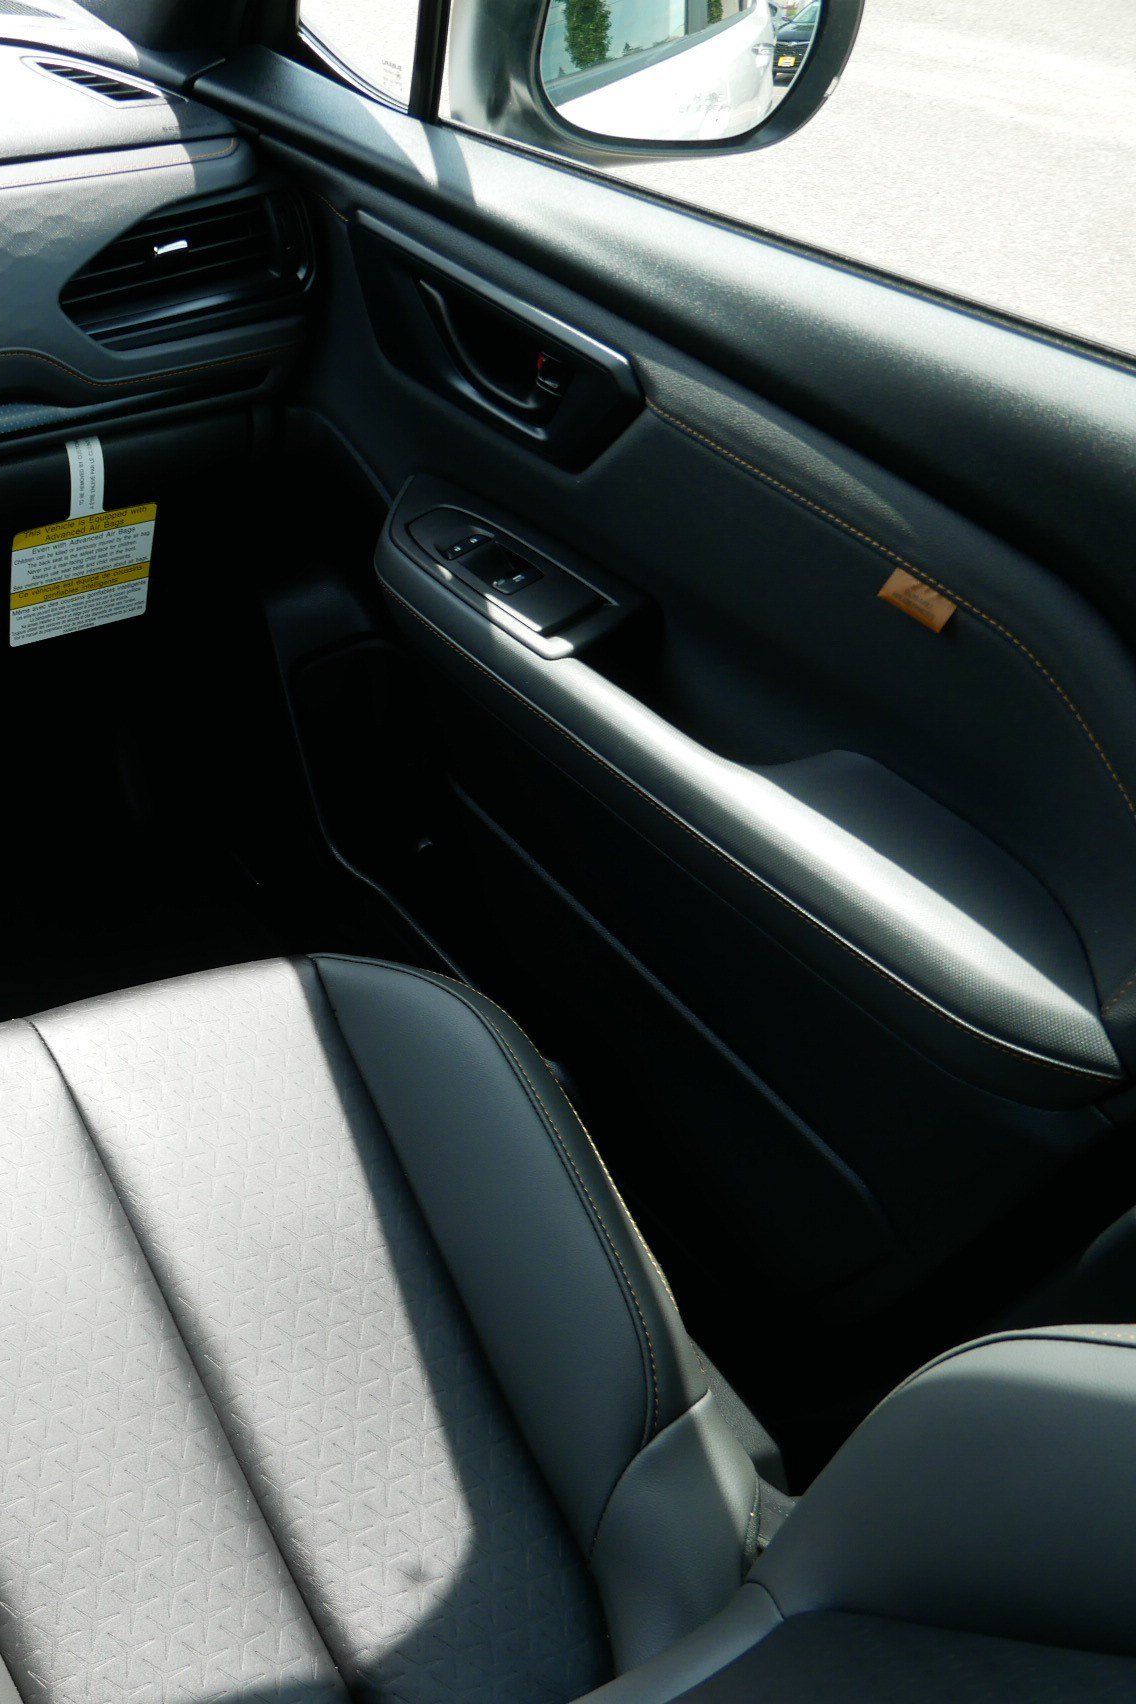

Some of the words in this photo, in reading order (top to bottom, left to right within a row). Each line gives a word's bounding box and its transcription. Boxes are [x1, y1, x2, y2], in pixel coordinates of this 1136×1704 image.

[23, 528, 40, 538] This
[44, 521, 75, 533] Vehicle
[78, 518, 85, 526] is
[88, 509, 127, 525] Equipped
[44, 526, 86, 541] Advanced
[88, 523, 100, 532] Air
[102, 518, 125, 530] Bags
[31, 544, 49, 554] Even
[52, 541, 66, 550] with
[68, 533, 103, 546] Advanced
[105, 530, 115, 538] Air
[117, 526, 136, 537] Bags
[18, 590, 28, 598] Ce
